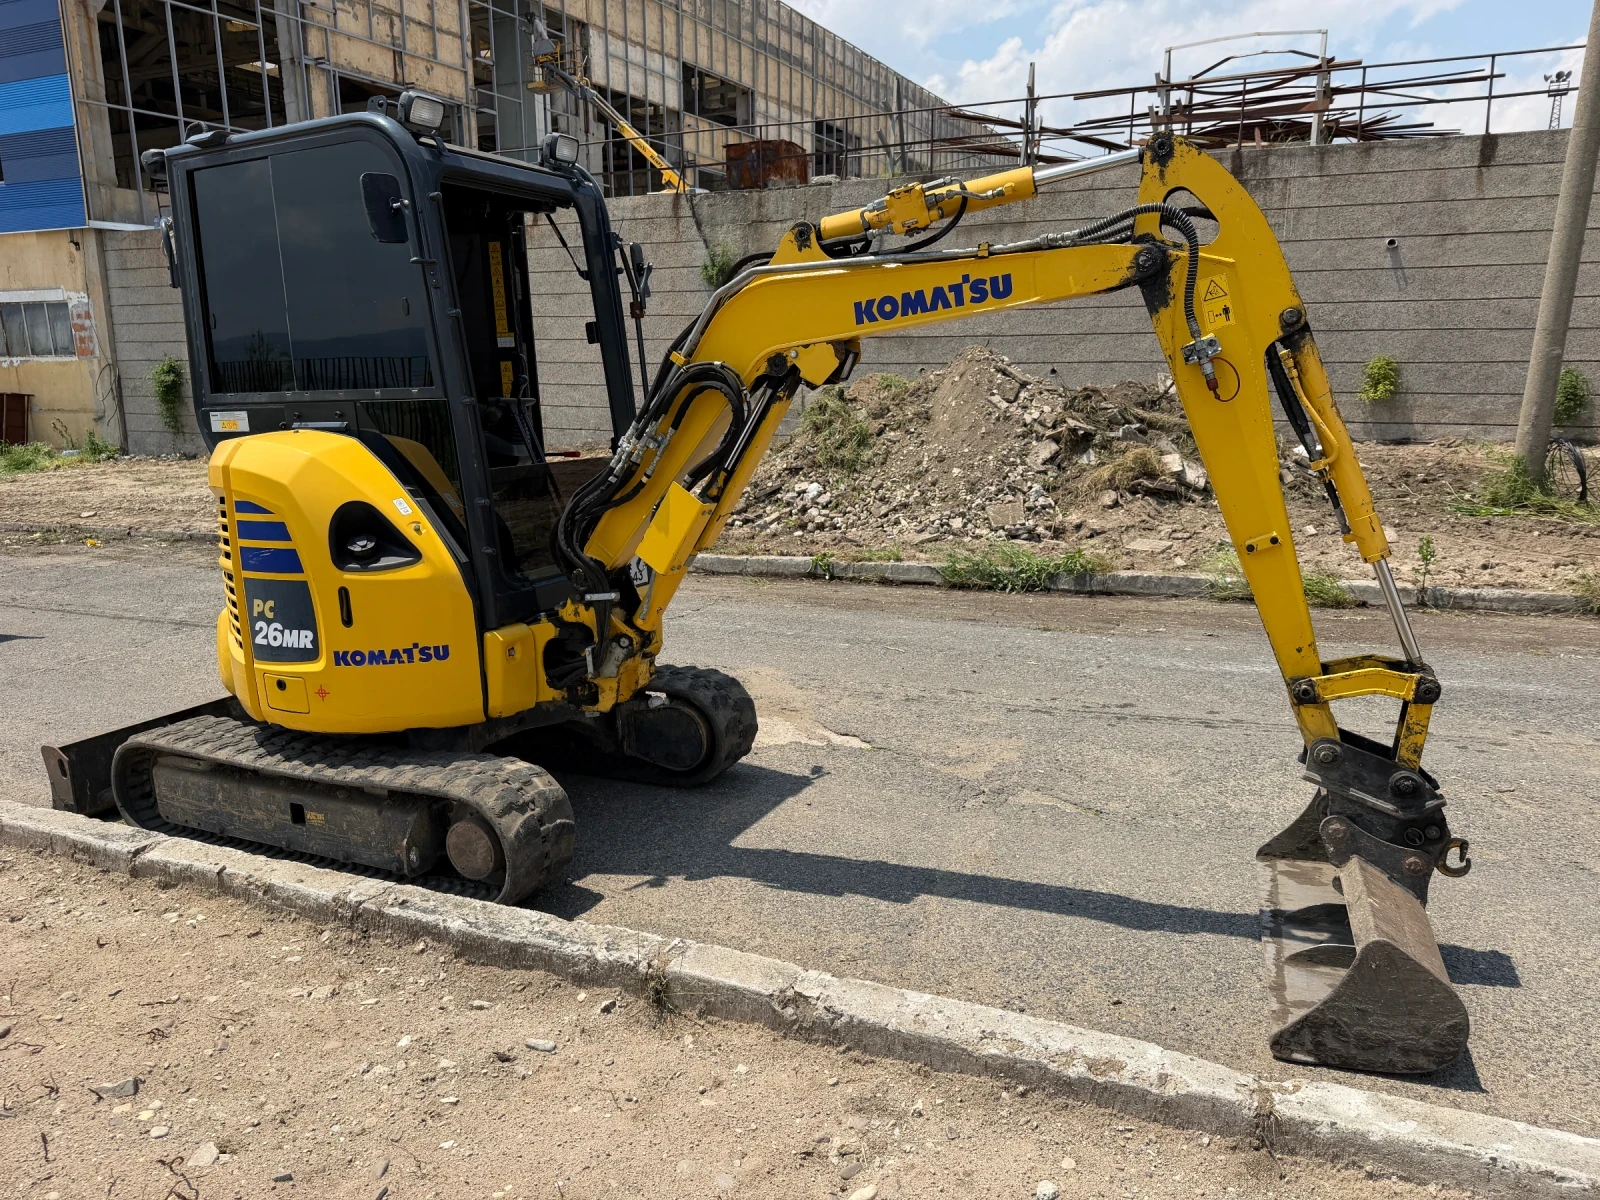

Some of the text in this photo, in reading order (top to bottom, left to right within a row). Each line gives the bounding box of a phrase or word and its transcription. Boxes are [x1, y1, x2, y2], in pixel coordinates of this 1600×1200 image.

[853, 273, 1013, 326] KOMATSU
[253, 598, 275, 619] PC
[254, 620, 314, 649] 26MR
[333, 642, 450, 667] KOMATSU
